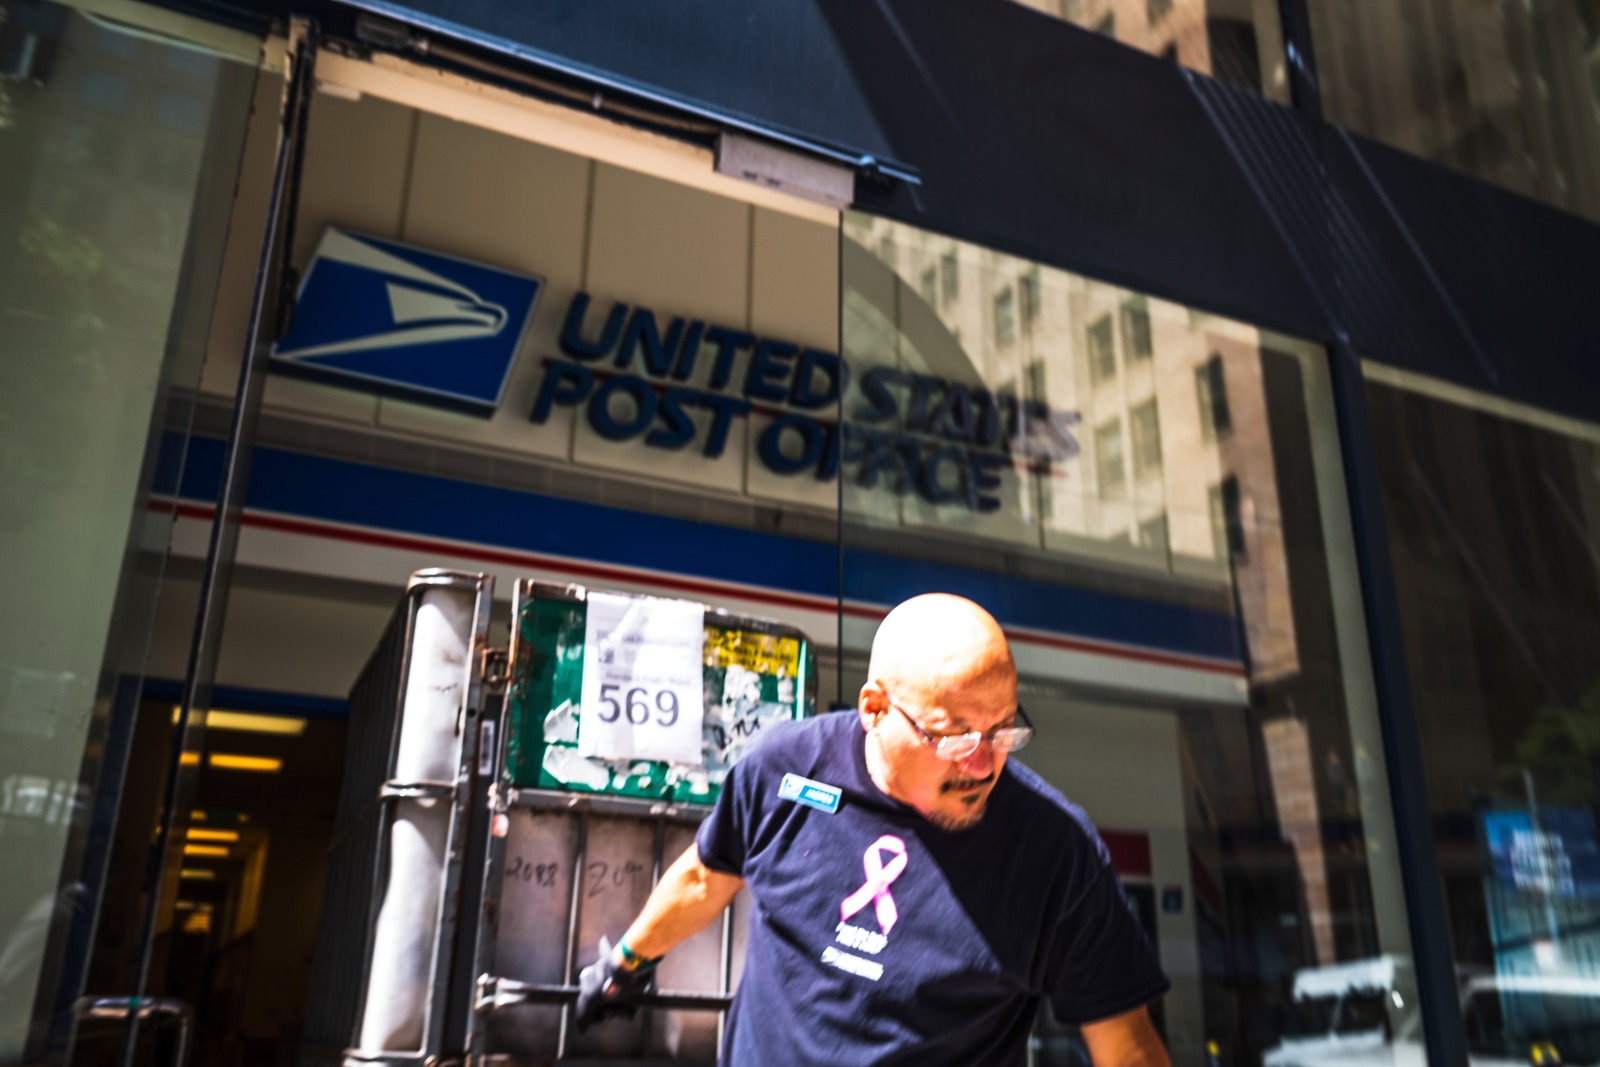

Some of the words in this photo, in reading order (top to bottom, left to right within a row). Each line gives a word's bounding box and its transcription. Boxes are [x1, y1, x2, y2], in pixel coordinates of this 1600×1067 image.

[558, 291, 849, 410] UNITED
[529, 358, 753, 461] POST
[597, 683, 679, 727] 569
